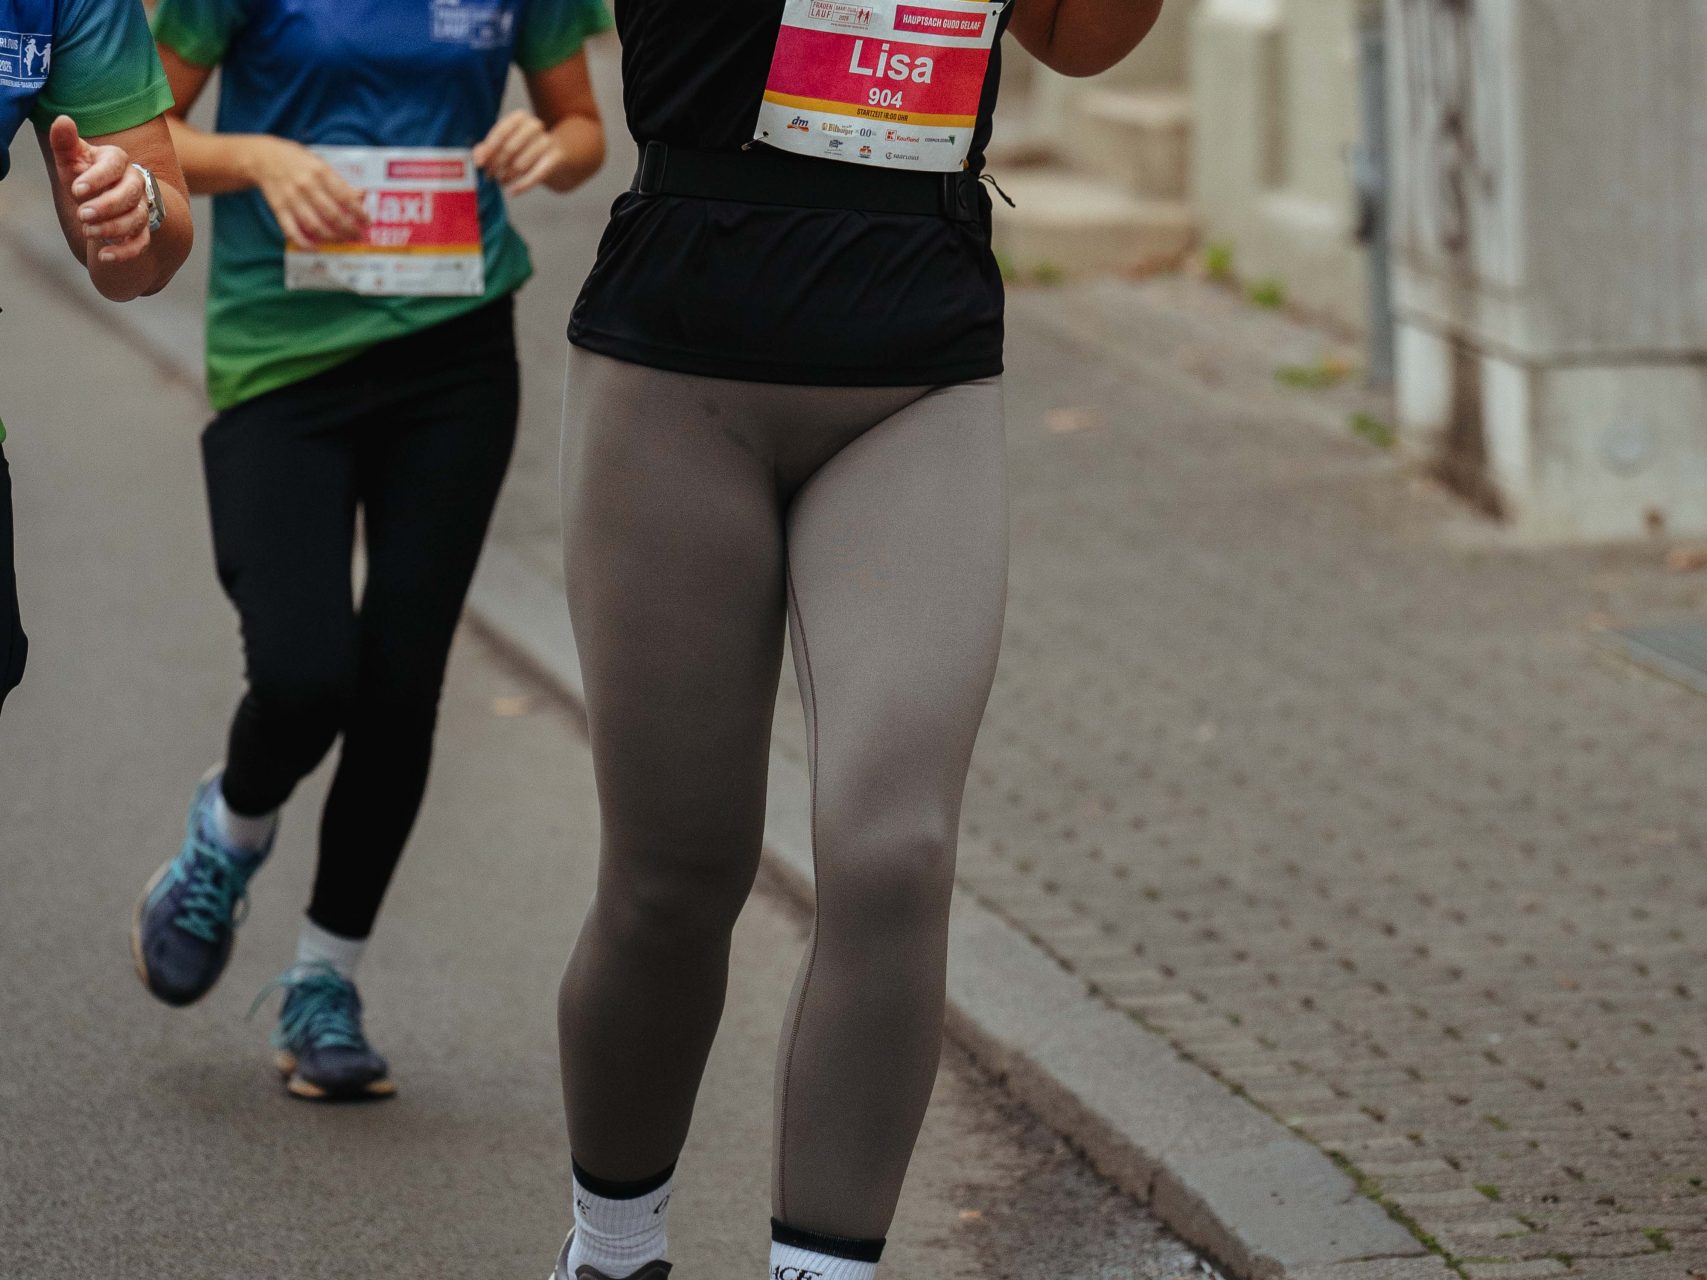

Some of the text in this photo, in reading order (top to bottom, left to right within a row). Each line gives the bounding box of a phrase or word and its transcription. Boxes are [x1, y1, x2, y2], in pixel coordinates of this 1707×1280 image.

[811, 8, 832, 18] LAUF
[902, 14, 942, 27] HAUPTSACH
[960, 20, 982, 31] GELAAF
[848, 39, 934, 84] Lisa
[868, 87, 903, 109] 904
[791, 115, 809, 127] dm
[856, 108, 883, 119] STARTZEIT
[897, 113, 909, 122] UHR
[896, 135, 920, 144] Kaufland
